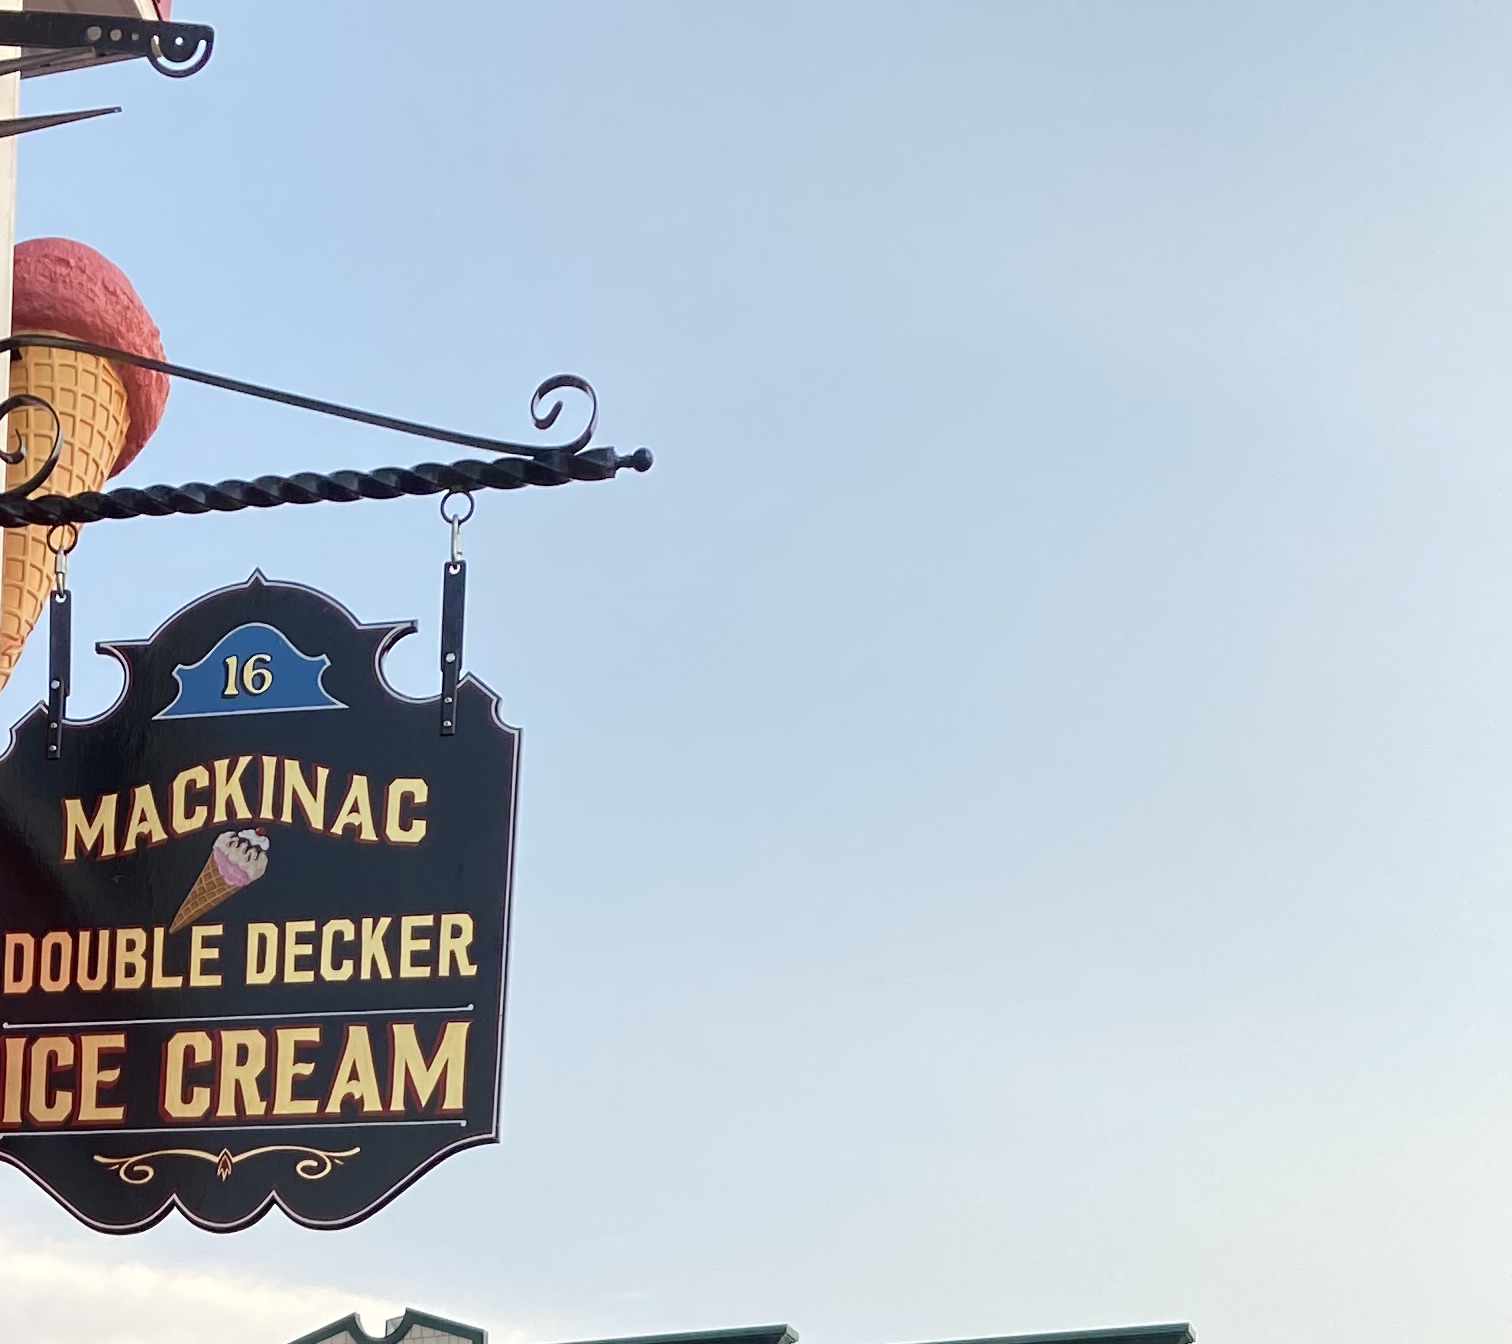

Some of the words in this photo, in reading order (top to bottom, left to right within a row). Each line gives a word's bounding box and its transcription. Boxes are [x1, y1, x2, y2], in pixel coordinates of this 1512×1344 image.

[222, 654, 273, 697] 16
[62, 753, 429, 863] MACKINAC
[2, 924, 224, 995] DOUBLE
[245, 912, 479, 986] DECKER
[163, 1021, 471, 1119] CREAM
